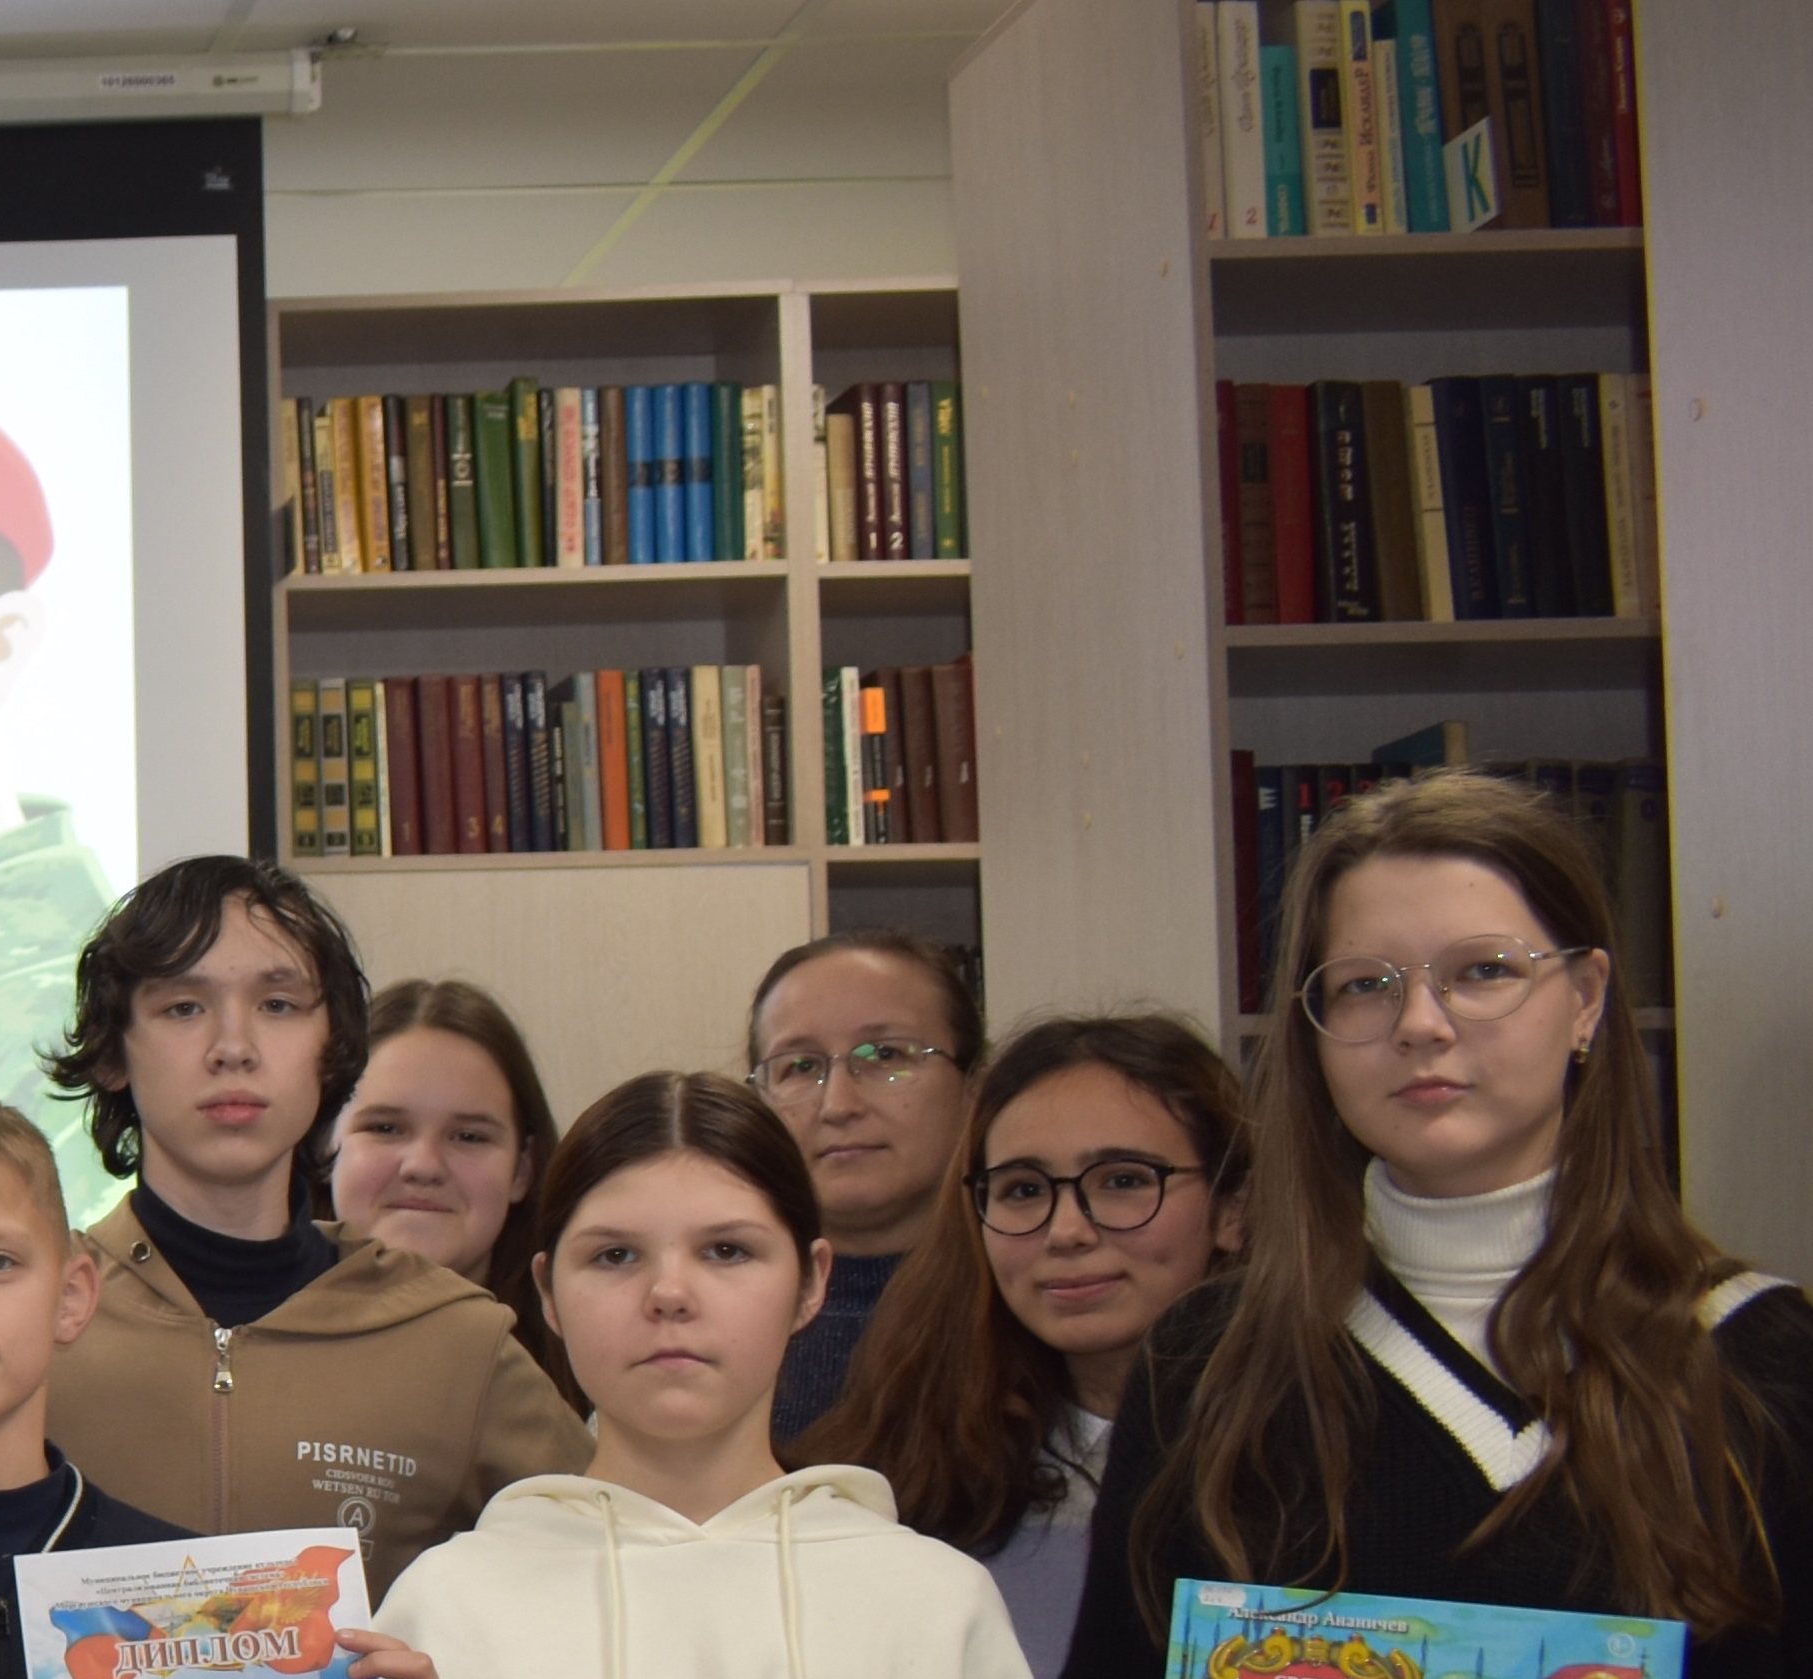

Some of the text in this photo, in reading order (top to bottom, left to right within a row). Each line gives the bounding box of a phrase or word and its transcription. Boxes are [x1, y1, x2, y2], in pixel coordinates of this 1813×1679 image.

[1459, 140, 1493, 223] К
[1323, 1611, 1409, 1633] Ананичев
[113, 1628, 299, 1678] ДИПЛОМ
